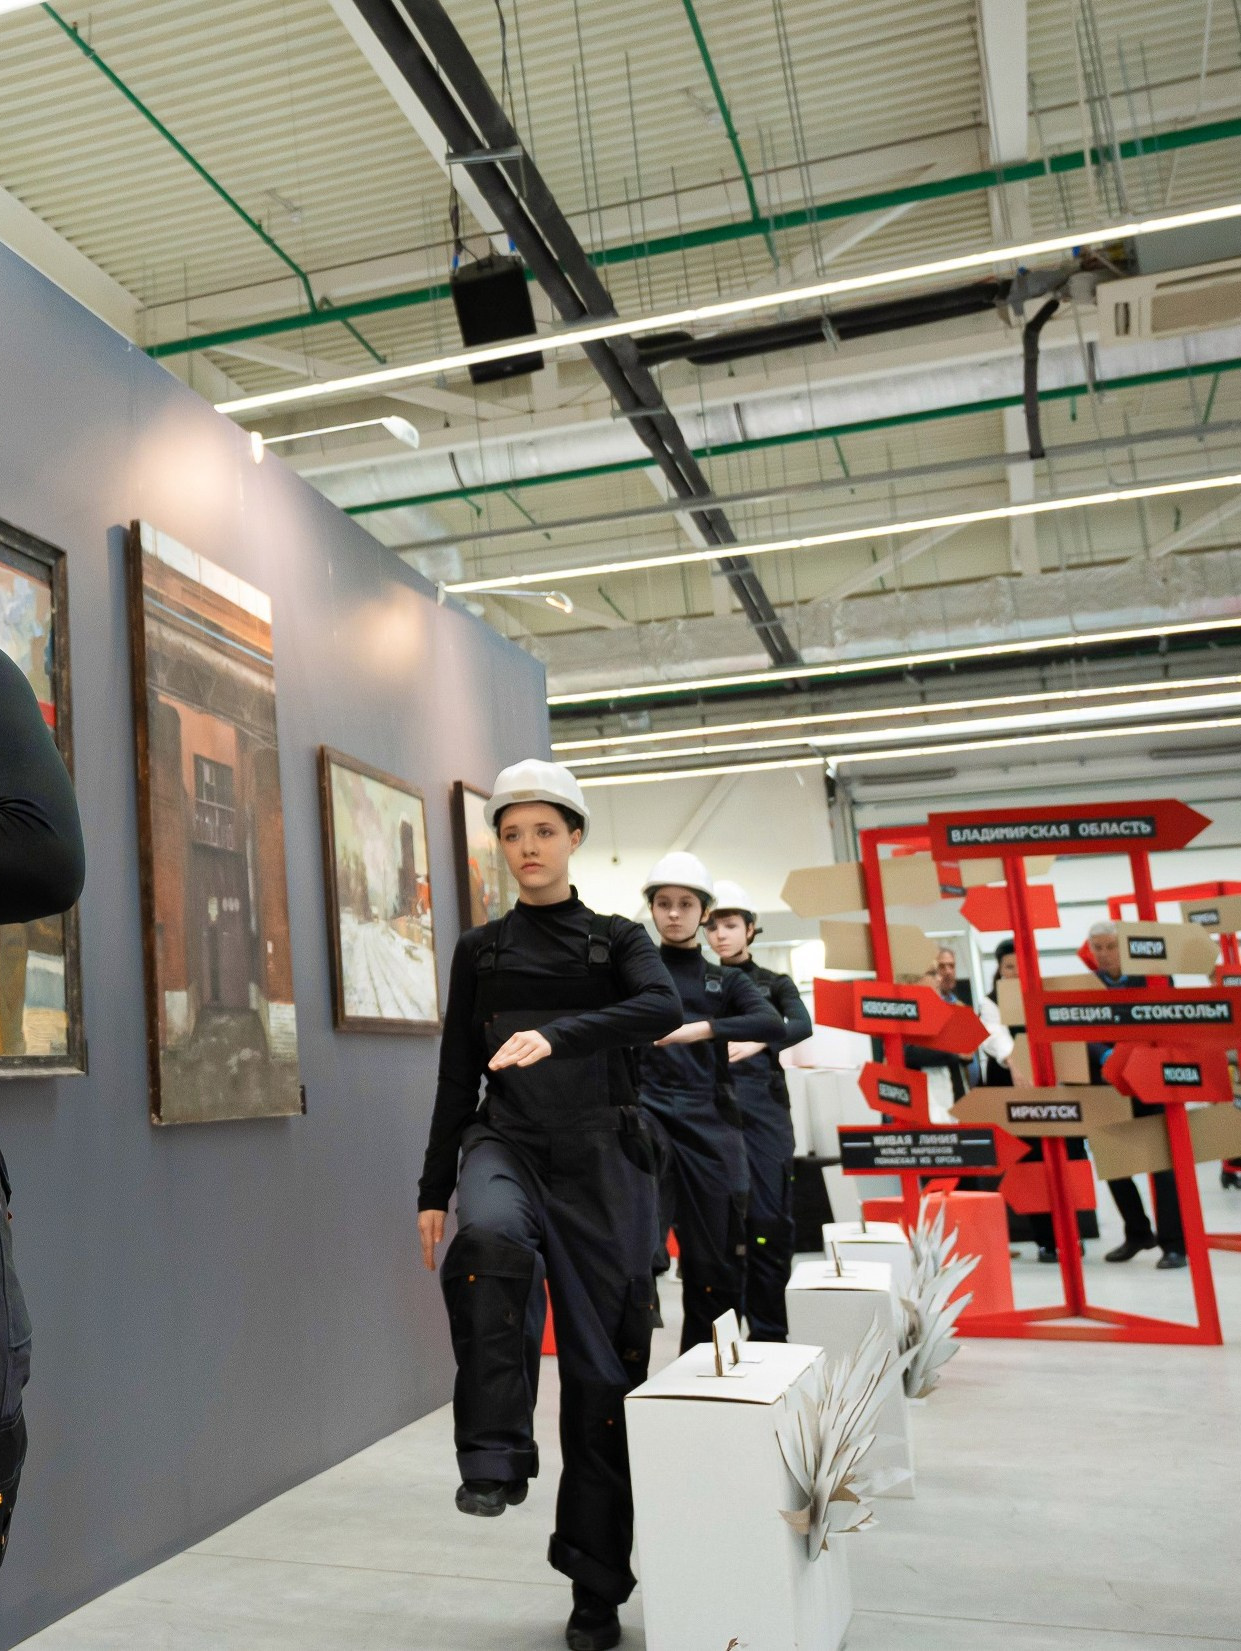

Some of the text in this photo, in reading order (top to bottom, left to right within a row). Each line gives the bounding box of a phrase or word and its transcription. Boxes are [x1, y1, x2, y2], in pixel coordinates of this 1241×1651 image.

[951, 820, 1151, 843] ВЛАДИМИРСКАЯ ОБЛАСТЬ
[1048, 1003, 1229, 1024] ШВЕЦИЯ, СТОКГОЛЬМ
[1163, 1067, 1199, 1081] МОСКВА
[1010, 1105, 1078, 1120] ИРКУТСК
[918, 1133, 958, 1145] ЛИНИЯ
